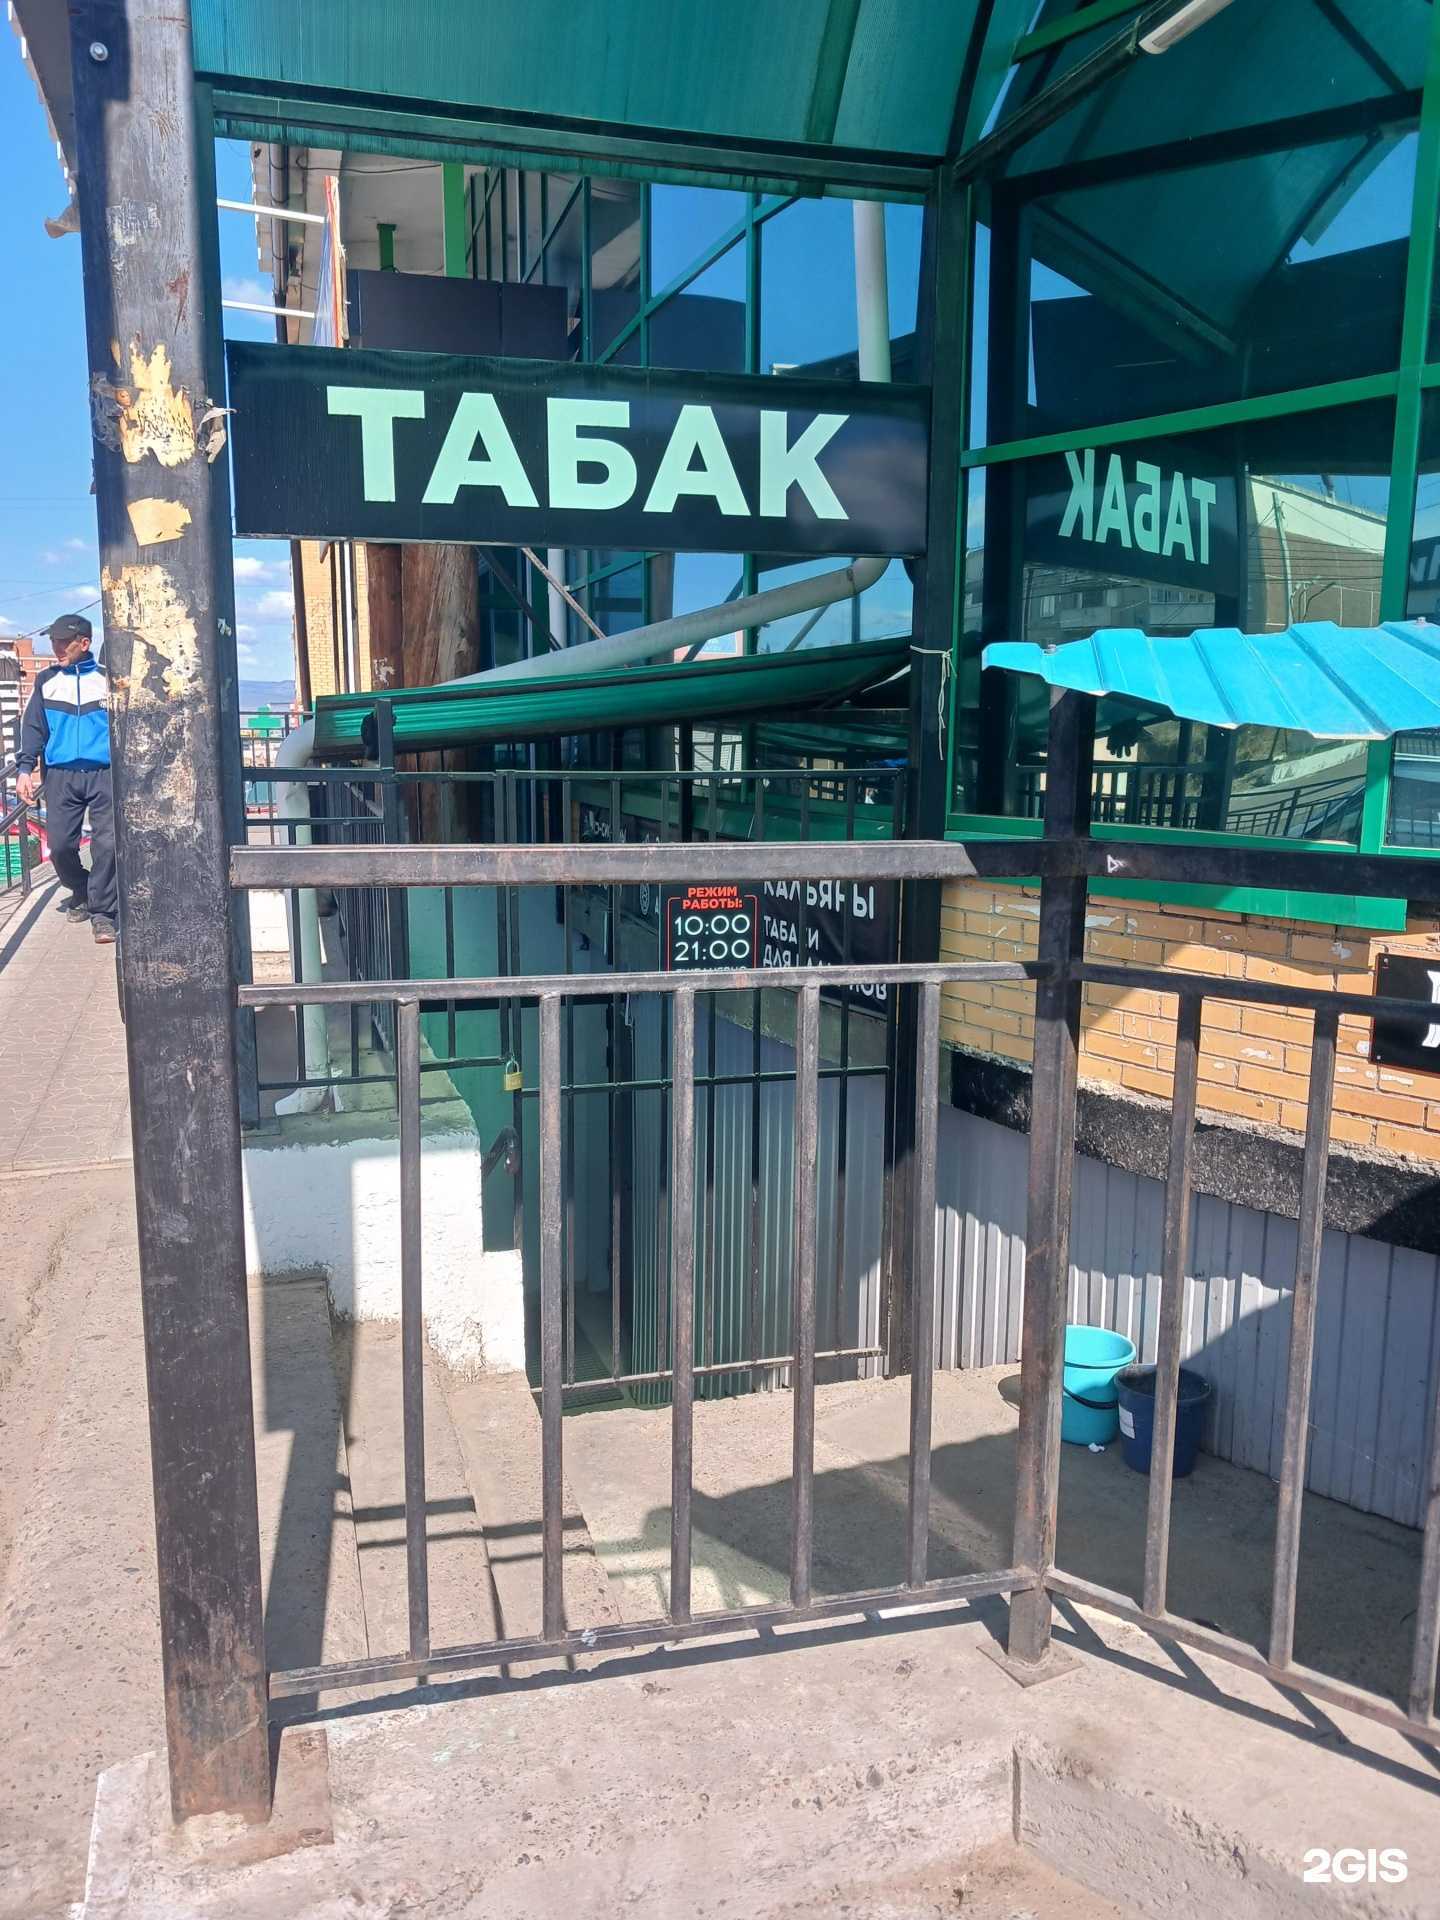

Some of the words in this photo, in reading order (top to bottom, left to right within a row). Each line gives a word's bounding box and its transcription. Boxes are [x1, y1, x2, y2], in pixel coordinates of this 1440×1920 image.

[326, 386, 850, 520] ТАБАК
[687, 886, 738, 899] РЕЖИМ
[682, 898, 743, 910] РАБОТЫ:
[674, 914, 750, 936] 10:00
[763, 915, 819, 951] ТАБАИ
[674, 939, 750, 961] 21:00
